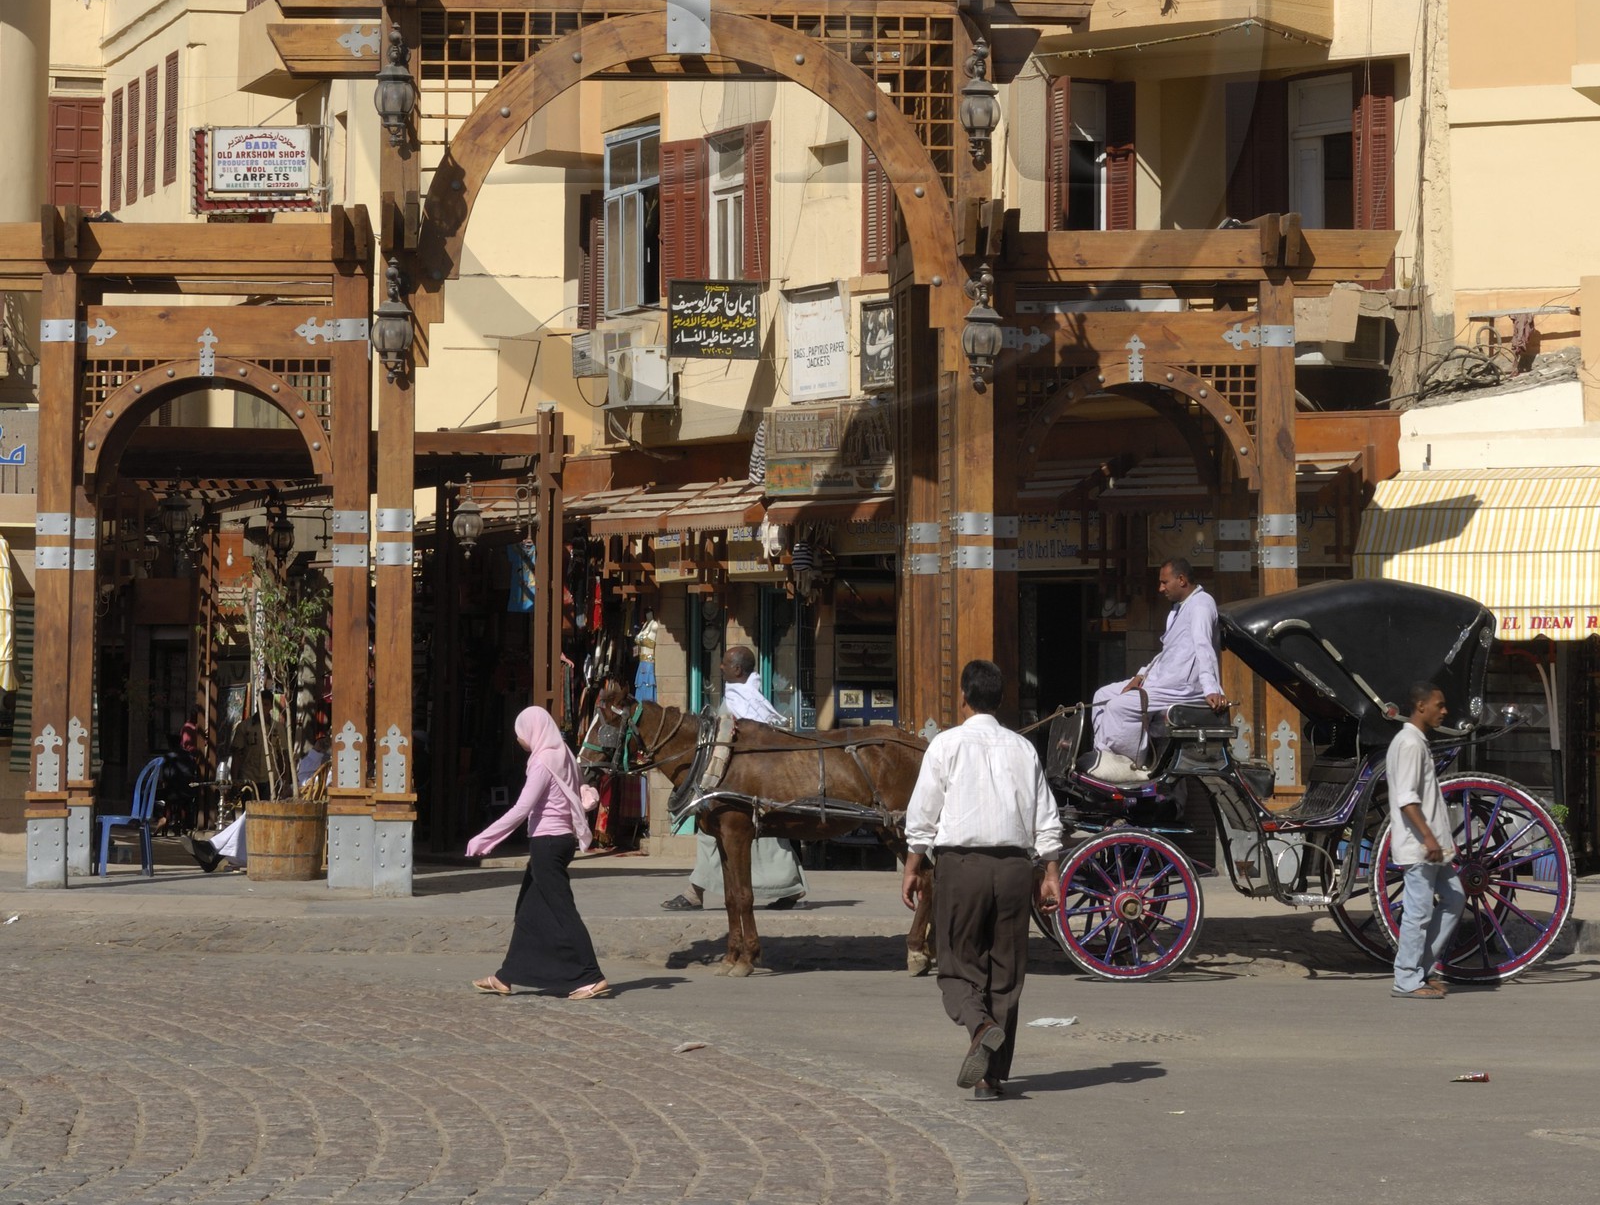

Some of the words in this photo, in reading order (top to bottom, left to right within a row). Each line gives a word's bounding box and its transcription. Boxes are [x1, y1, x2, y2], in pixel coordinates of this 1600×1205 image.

[245, 141, 278, 150] BADR
[217, 151, 233, 159] OLD
[235, 150, 276, 159] ARKSHOM
[278, 150, 306, 158] SHOPS
[234, 172, 290, 182] CARPETS
[829, 341, 845, 353] PAPER
[806, 355, 831, 369] JACKETS
[1502, 616, 1521, 630] EL
[1529, 616, 1575, 630] DEAN
